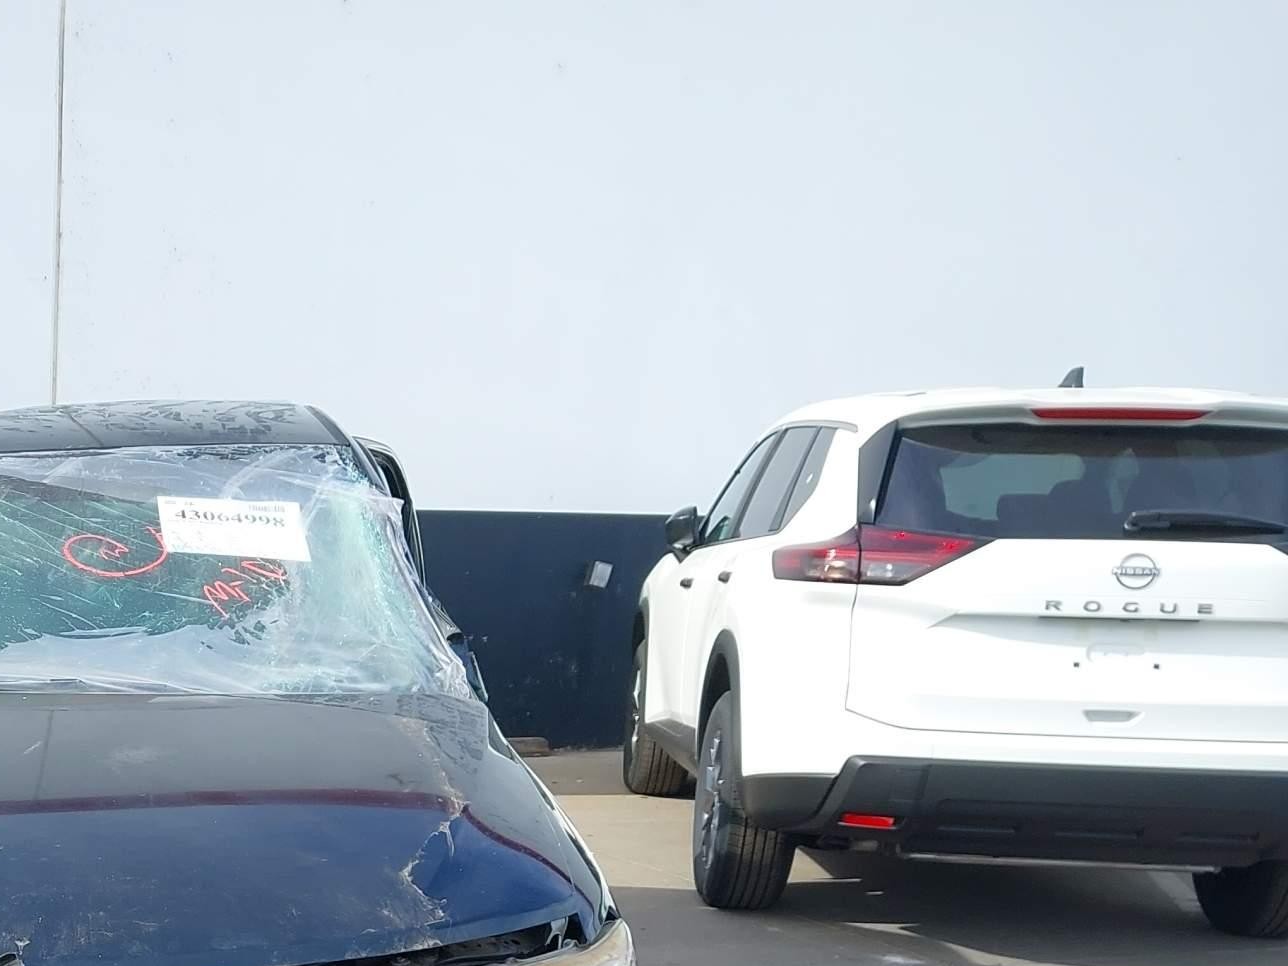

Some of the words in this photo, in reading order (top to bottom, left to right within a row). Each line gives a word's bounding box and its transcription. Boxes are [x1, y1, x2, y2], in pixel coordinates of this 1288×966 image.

[175, 508, 286, 528] 43064998
[1111, 566, 1161, 577] NISSAN
[1045, 600, 1214, 615] ROGUE
